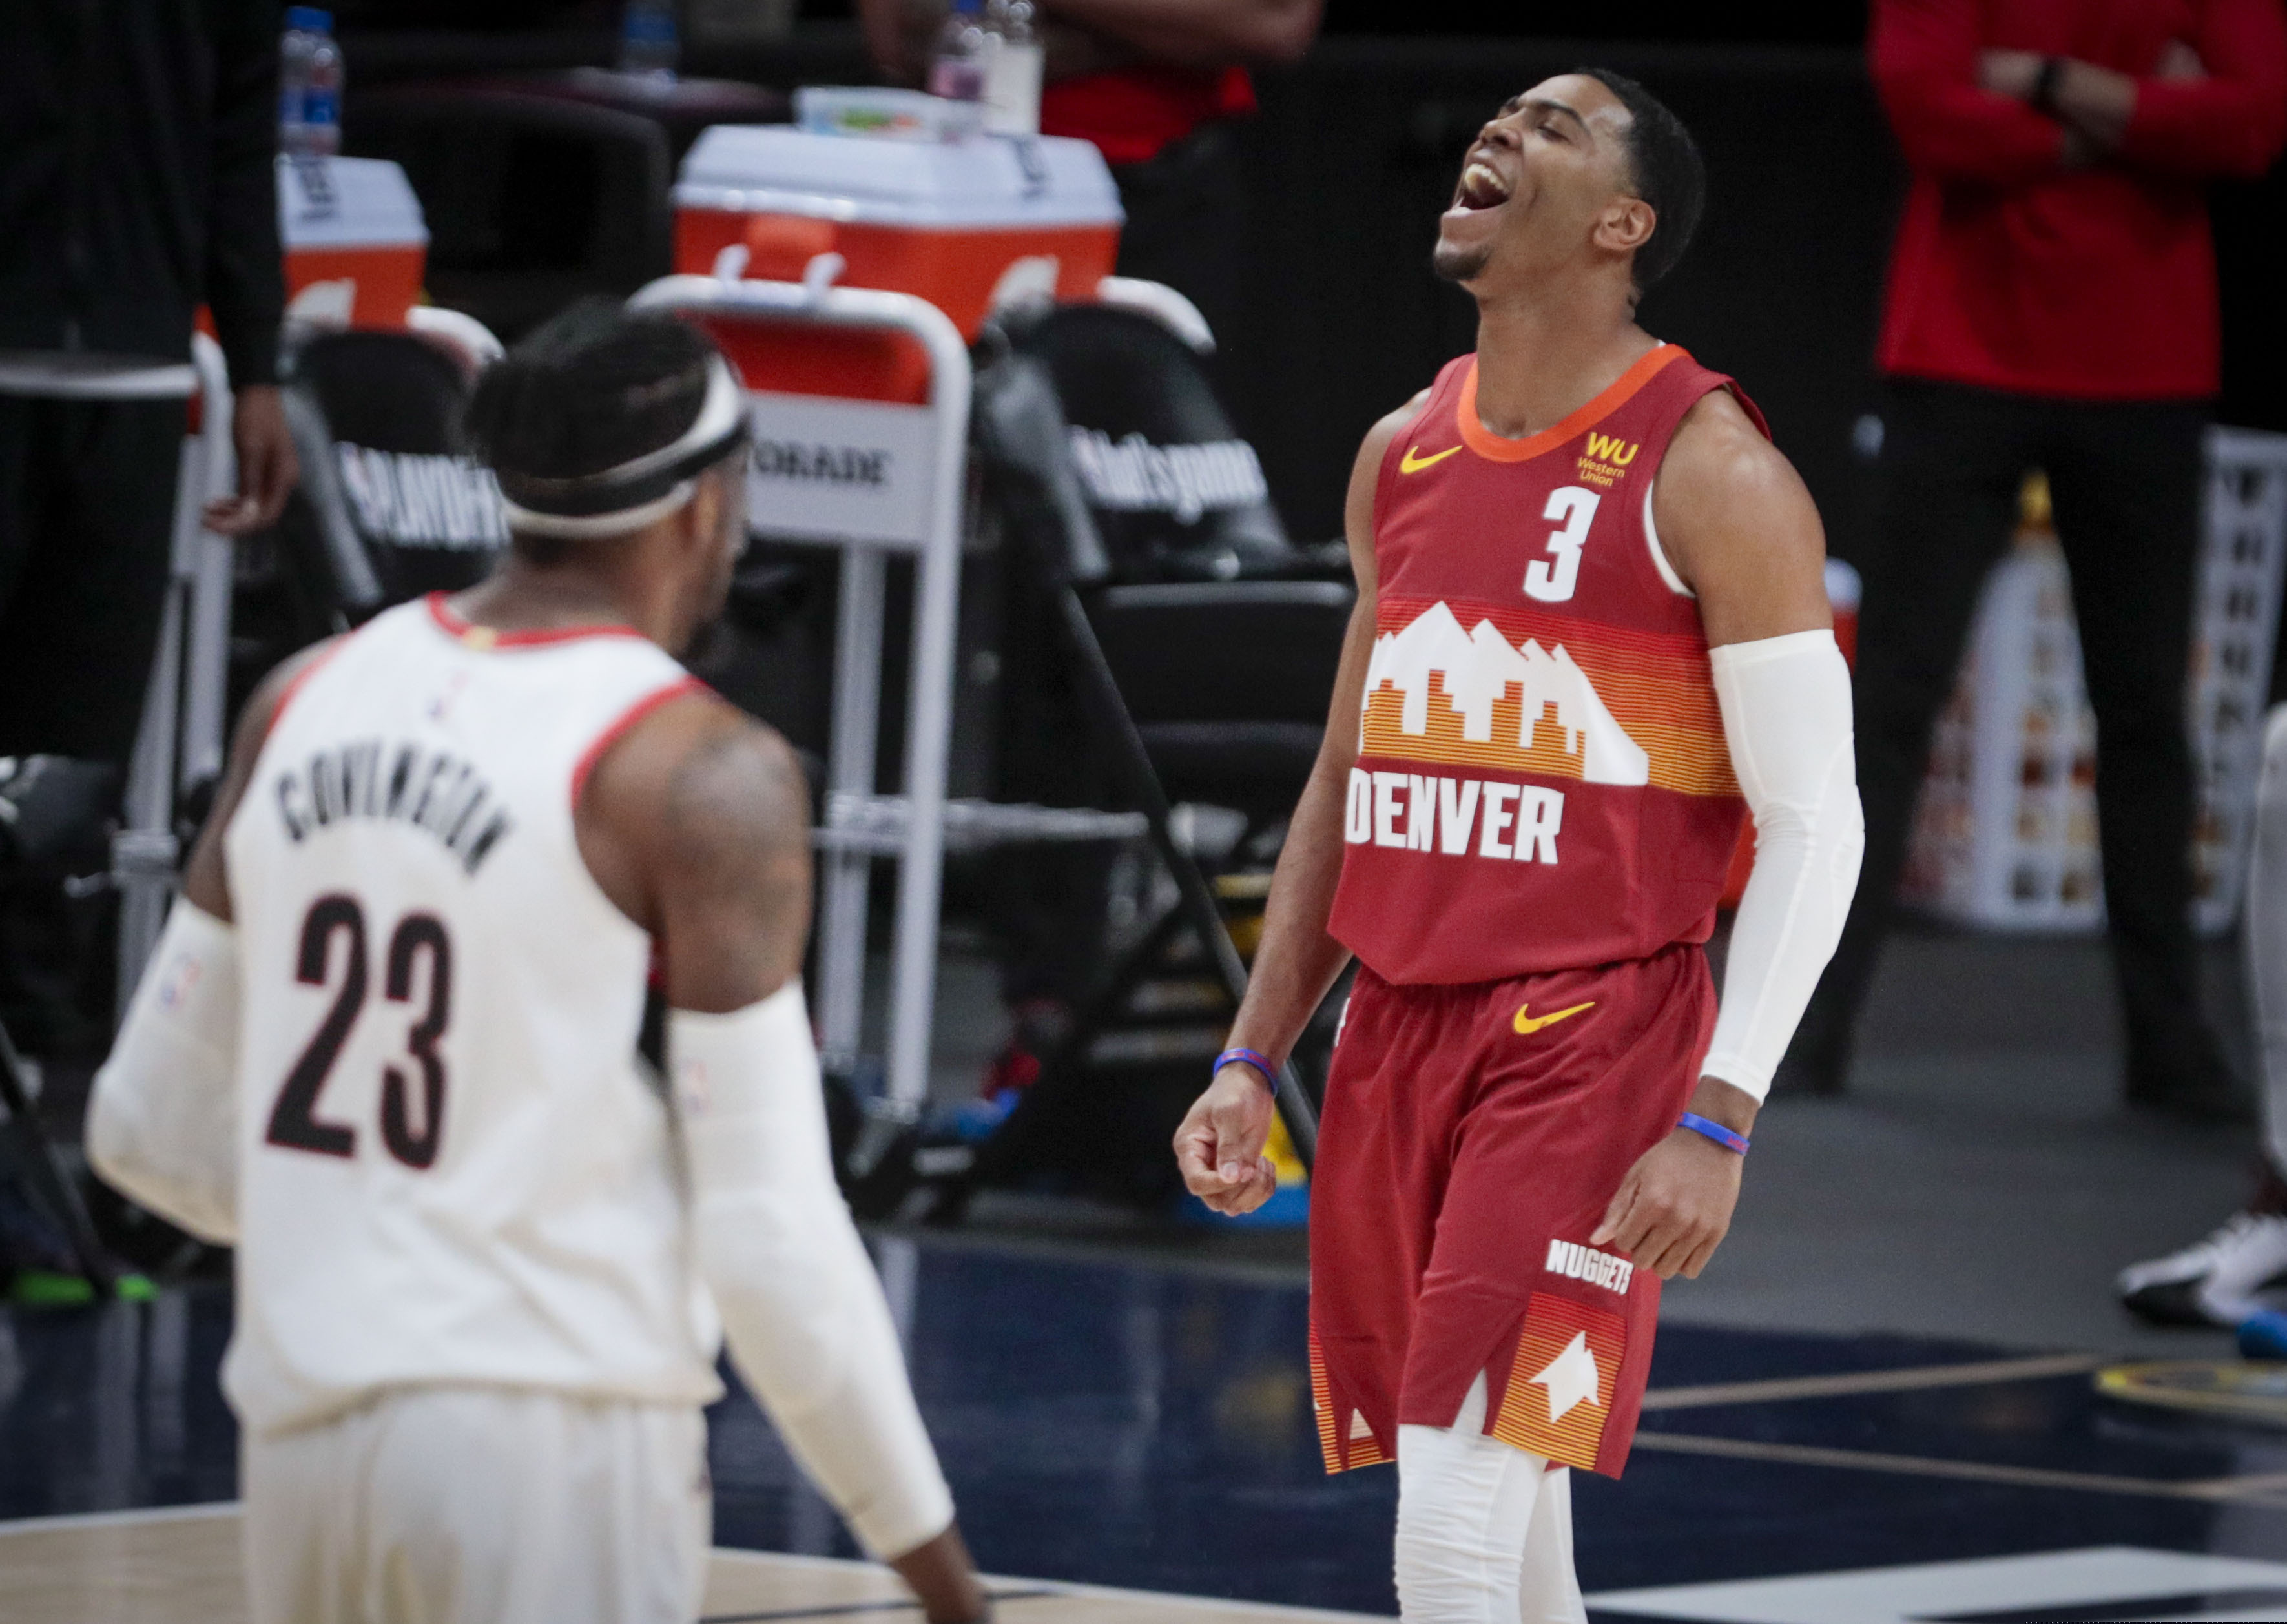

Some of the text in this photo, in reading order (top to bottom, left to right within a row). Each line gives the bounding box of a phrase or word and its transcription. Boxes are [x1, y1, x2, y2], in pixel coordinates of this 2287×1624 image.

[1577, 457, 1625, 478] Western
[1580, 469, 1614, 487] Union
[1587, 432, 1639, 465] WU
[1522, 486, 1602, 602] 3
[276, 740, 514, 877] COVINGTON
[1345, 767, 1564, 865] DENVER
[264, 892, 454, 1170] 23
[1545, 1239, 1634, 1295] NUGGETS
